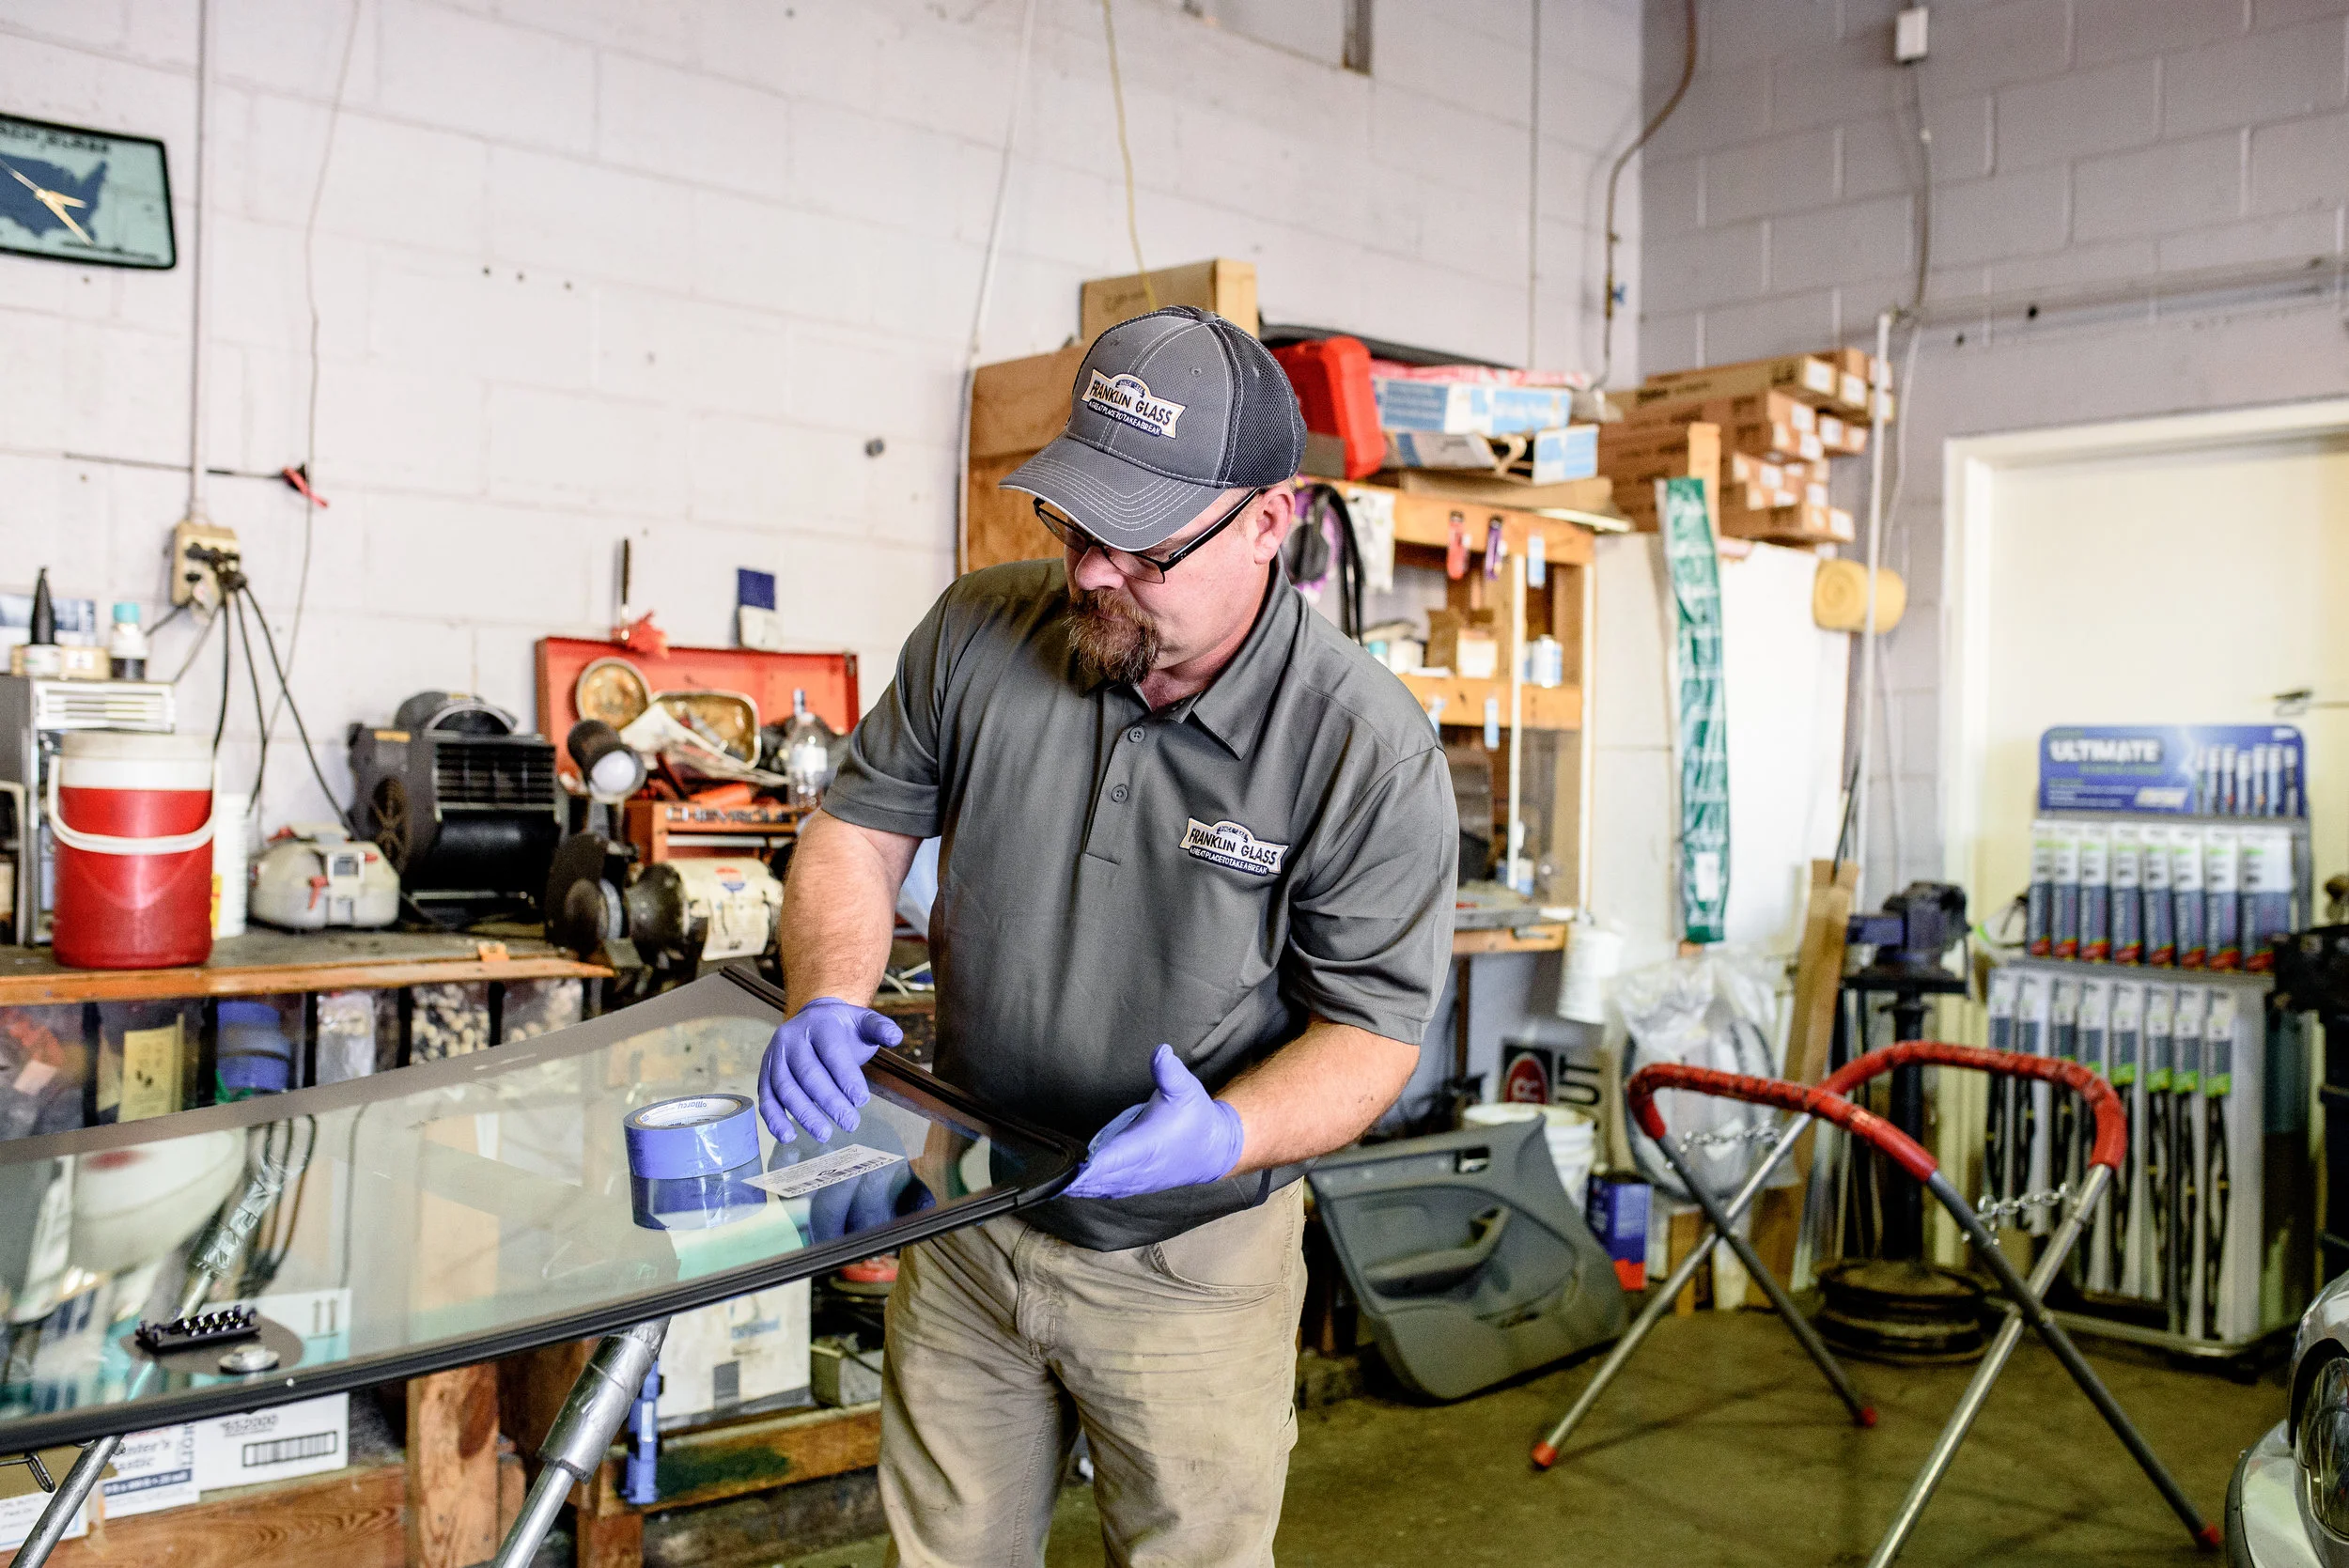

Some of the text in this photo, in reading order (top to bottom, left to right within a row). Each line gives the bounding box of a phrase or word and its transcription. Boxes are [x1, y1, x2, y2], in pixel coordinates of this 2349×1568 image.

[1090, 380, 1131, 408] FRANKLIN
[1135, 400, 1173, 426] GLASS
[2049, 738, 2160, 762] ULTIMATE
[1189, 828, 1236, 852] FRANKLIN
[1241, 846, 1277, 864] GLASS
